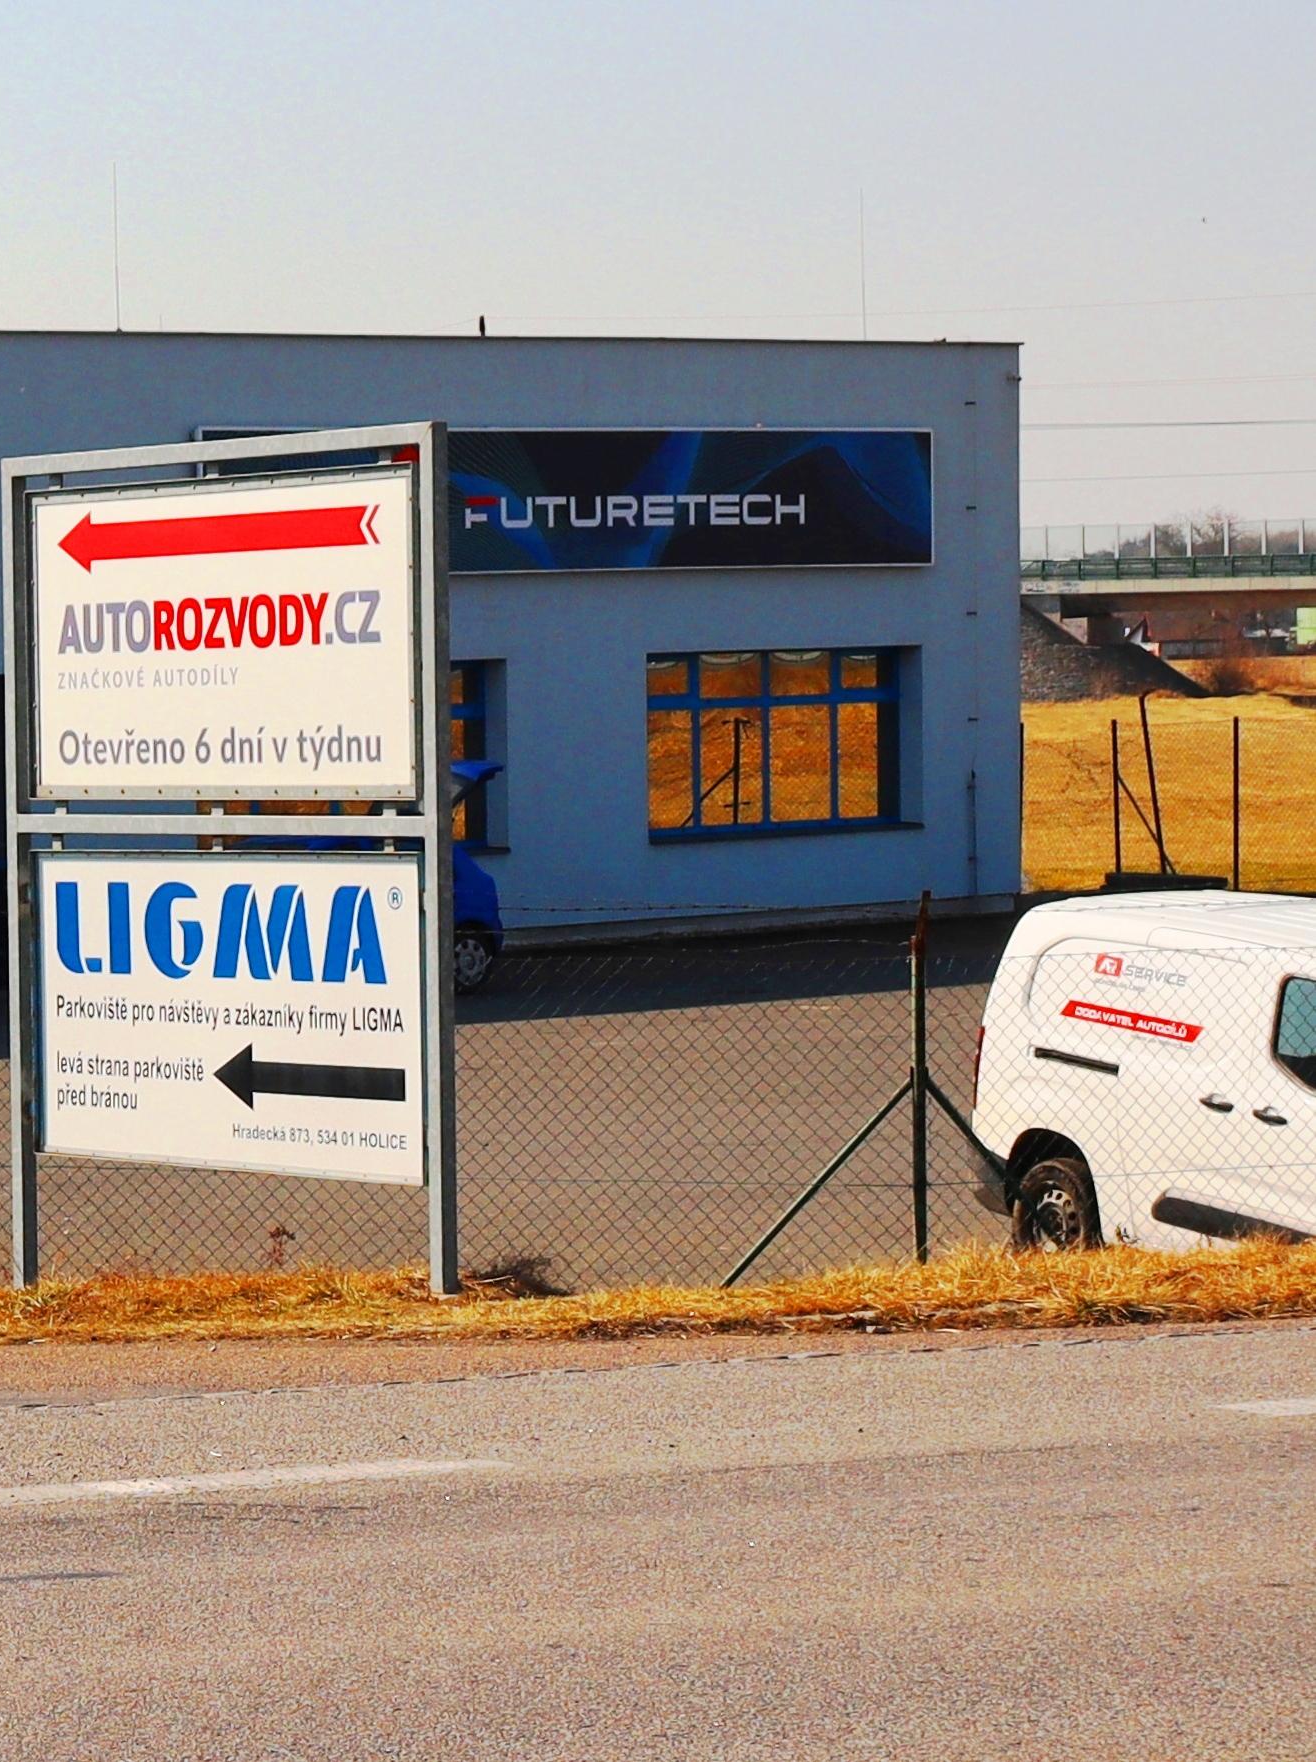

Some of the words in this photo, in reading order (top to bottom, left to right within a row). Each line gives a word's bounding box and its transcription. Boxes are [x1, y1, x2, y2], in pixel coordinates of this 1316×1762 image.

[465, 494, 805, 529] FUTURETECH
[57, 590, 381, 654] AUTOROZVODY.CZ
[57, 666, 144, 690] ZNAČKOVÉ
[153, 665, 238, 687] AUTODÍLY
[59, 729, 185, 765] Otevřeno
[195, 727, 211, 763] 6
[221, 726, 265, 763] dní
[272, 736, 288, 762] v
[297, 724, 382, 771] týdnu
[55, 881, 388, 985] LIGMA
[1123, 964, 1188, 987] SERVICE
[56, 994, 128, 1021] Parkoviště
[132, 1002, 155, 1026] pro
[159, 999, 219, 1030] návštěvy
[223, 1008, 231, 1025] a
[235, 1002, 304, 1034] zákazníky
[309, 1004, 347, 1036] firmy
[352, 1006, 404, 1032] LIGMA
[57, 1050, 83, 1074] levá
[87, 1053, 129, 1076] strana
[134, 1056, 204, 1083] parkoviště
[57, 1083, 86, 1110] před
[91, 1084, 138, 1109] bránou
[232, 1123, 286, 1142] Hradecká
[289, 1128, 314, 1146] 873,
[318, 1129, 338, 1145] 534
[341, 1131, 355, 1146] 01
[359, 1132, 407, 1150] HOLICE
